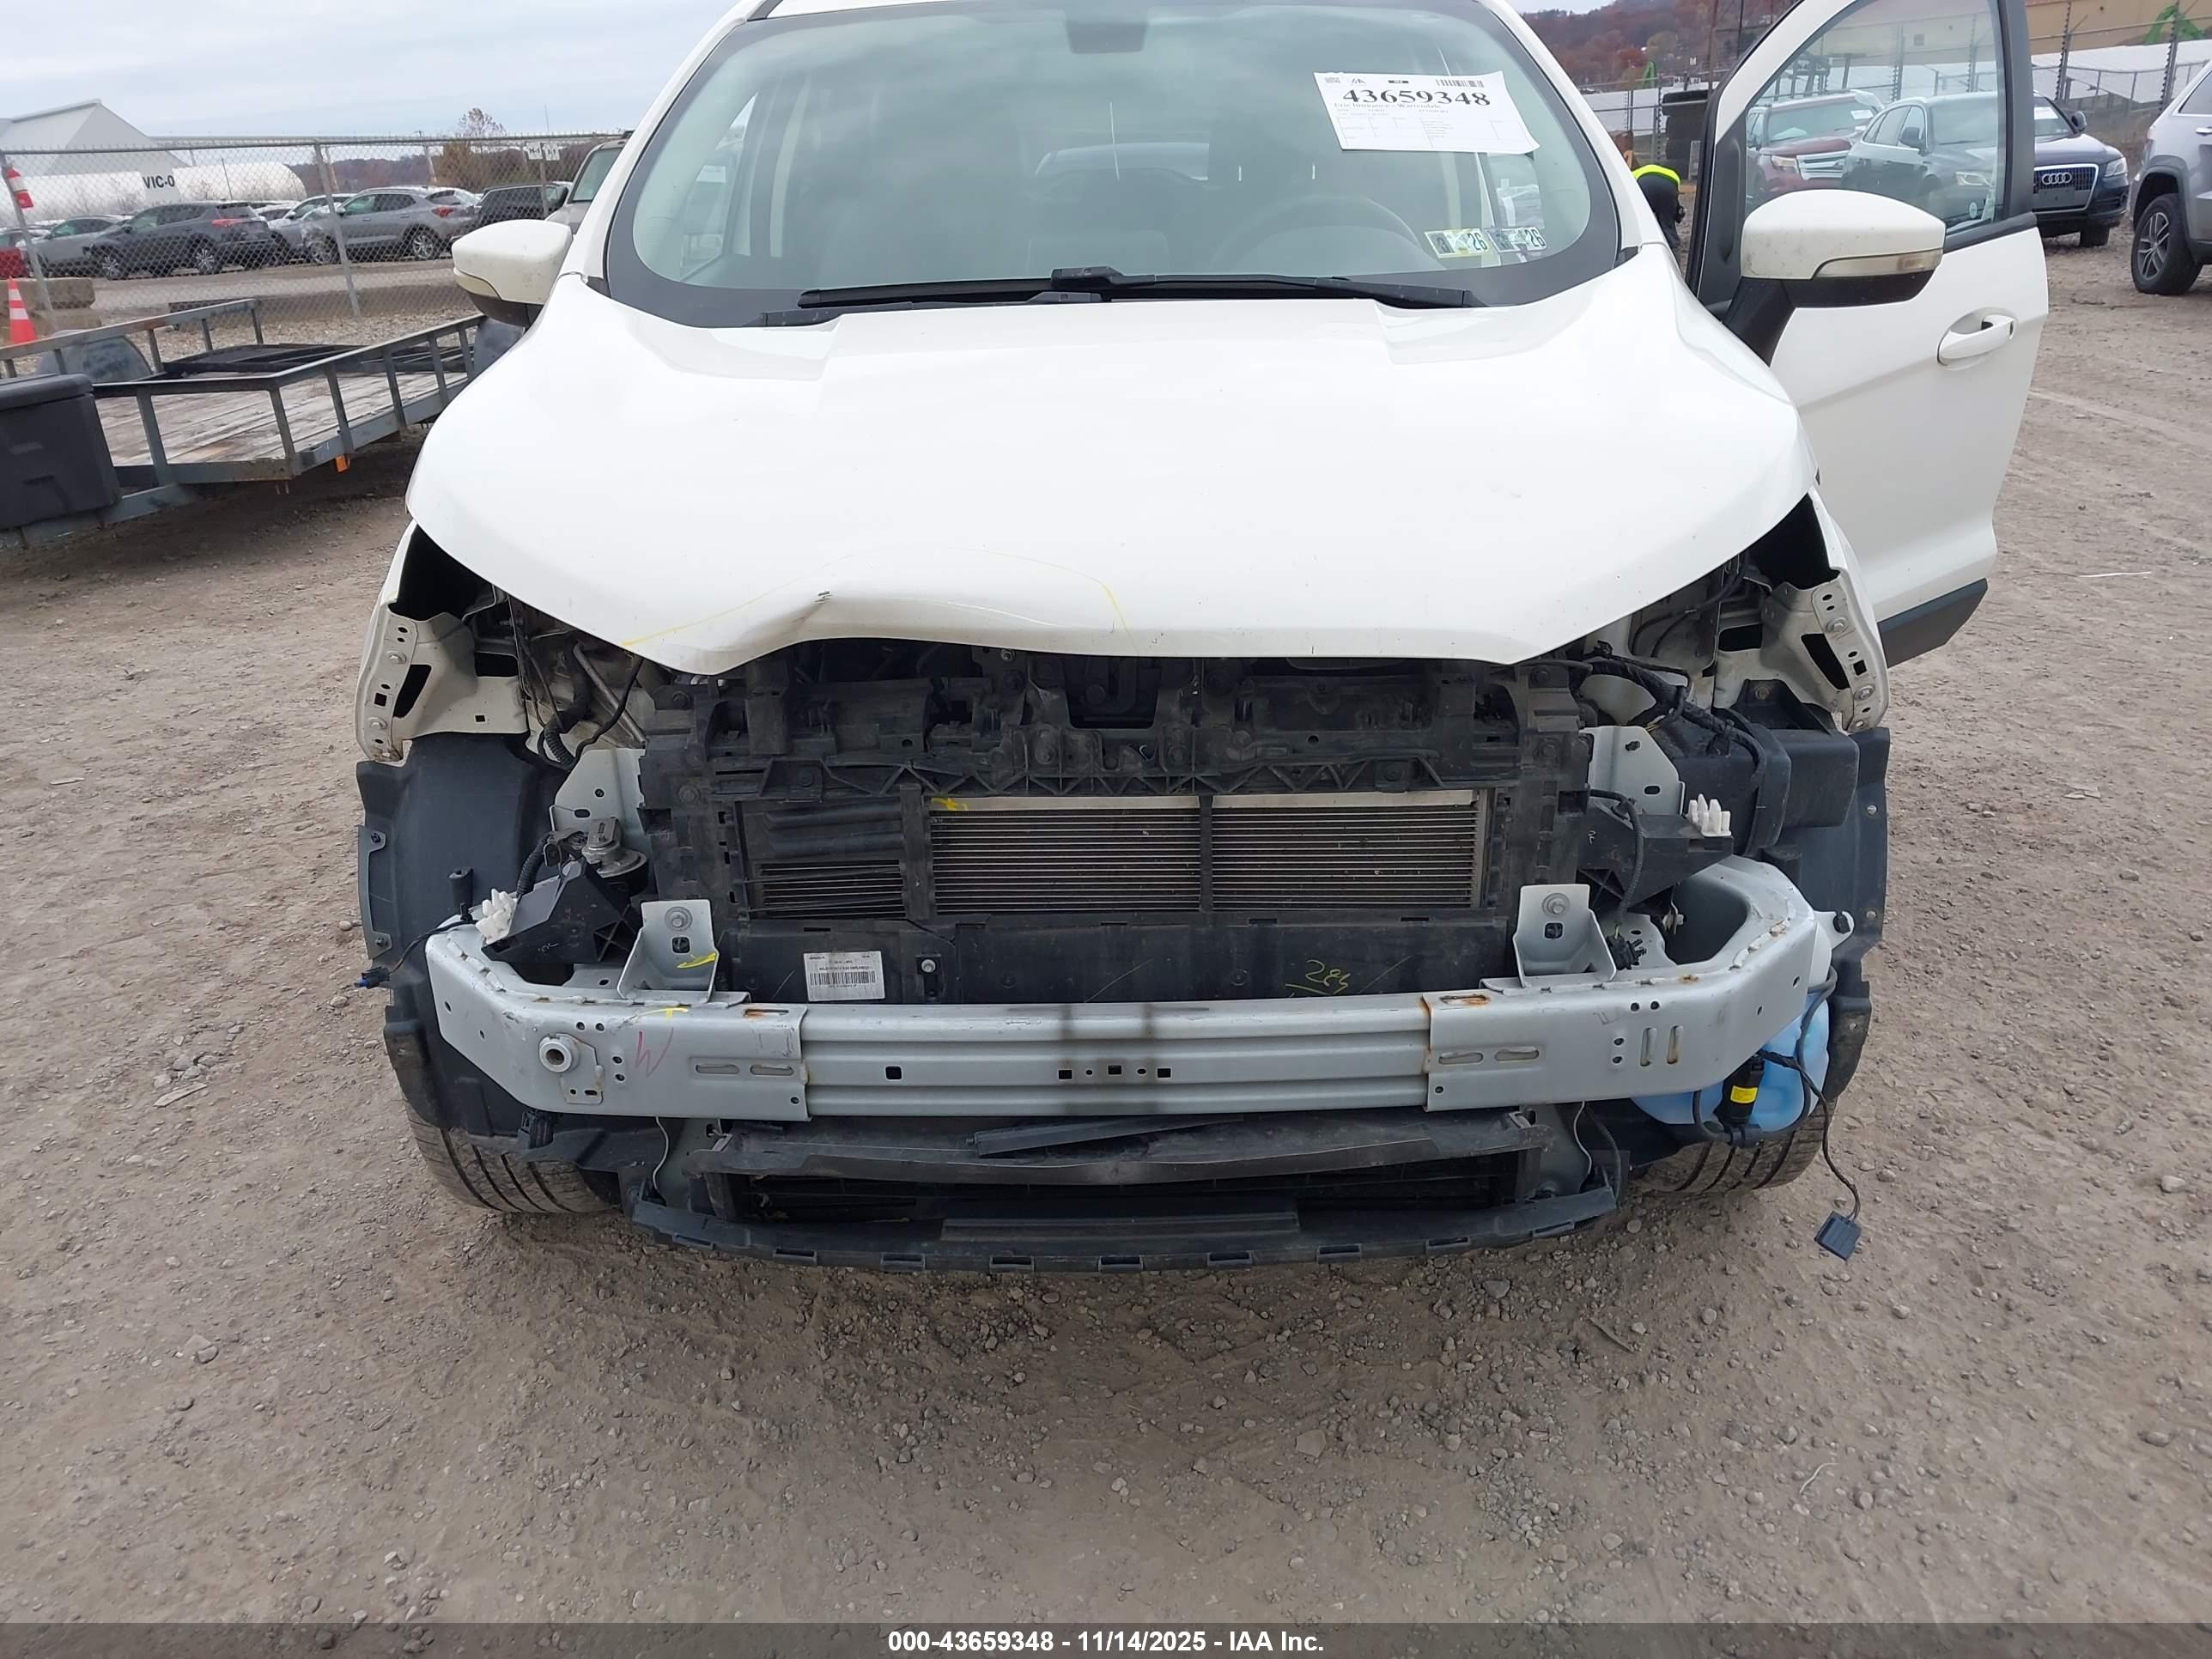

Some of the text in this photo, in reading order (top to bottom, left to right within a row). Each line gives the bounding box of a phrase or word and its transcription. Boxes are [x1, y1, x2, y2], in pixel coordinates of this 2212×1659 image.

[1343, 88, 1491, 106] 43659348
[1467, 232, 1489, 252] 26
[1524, 228, 1547, 247] 26
